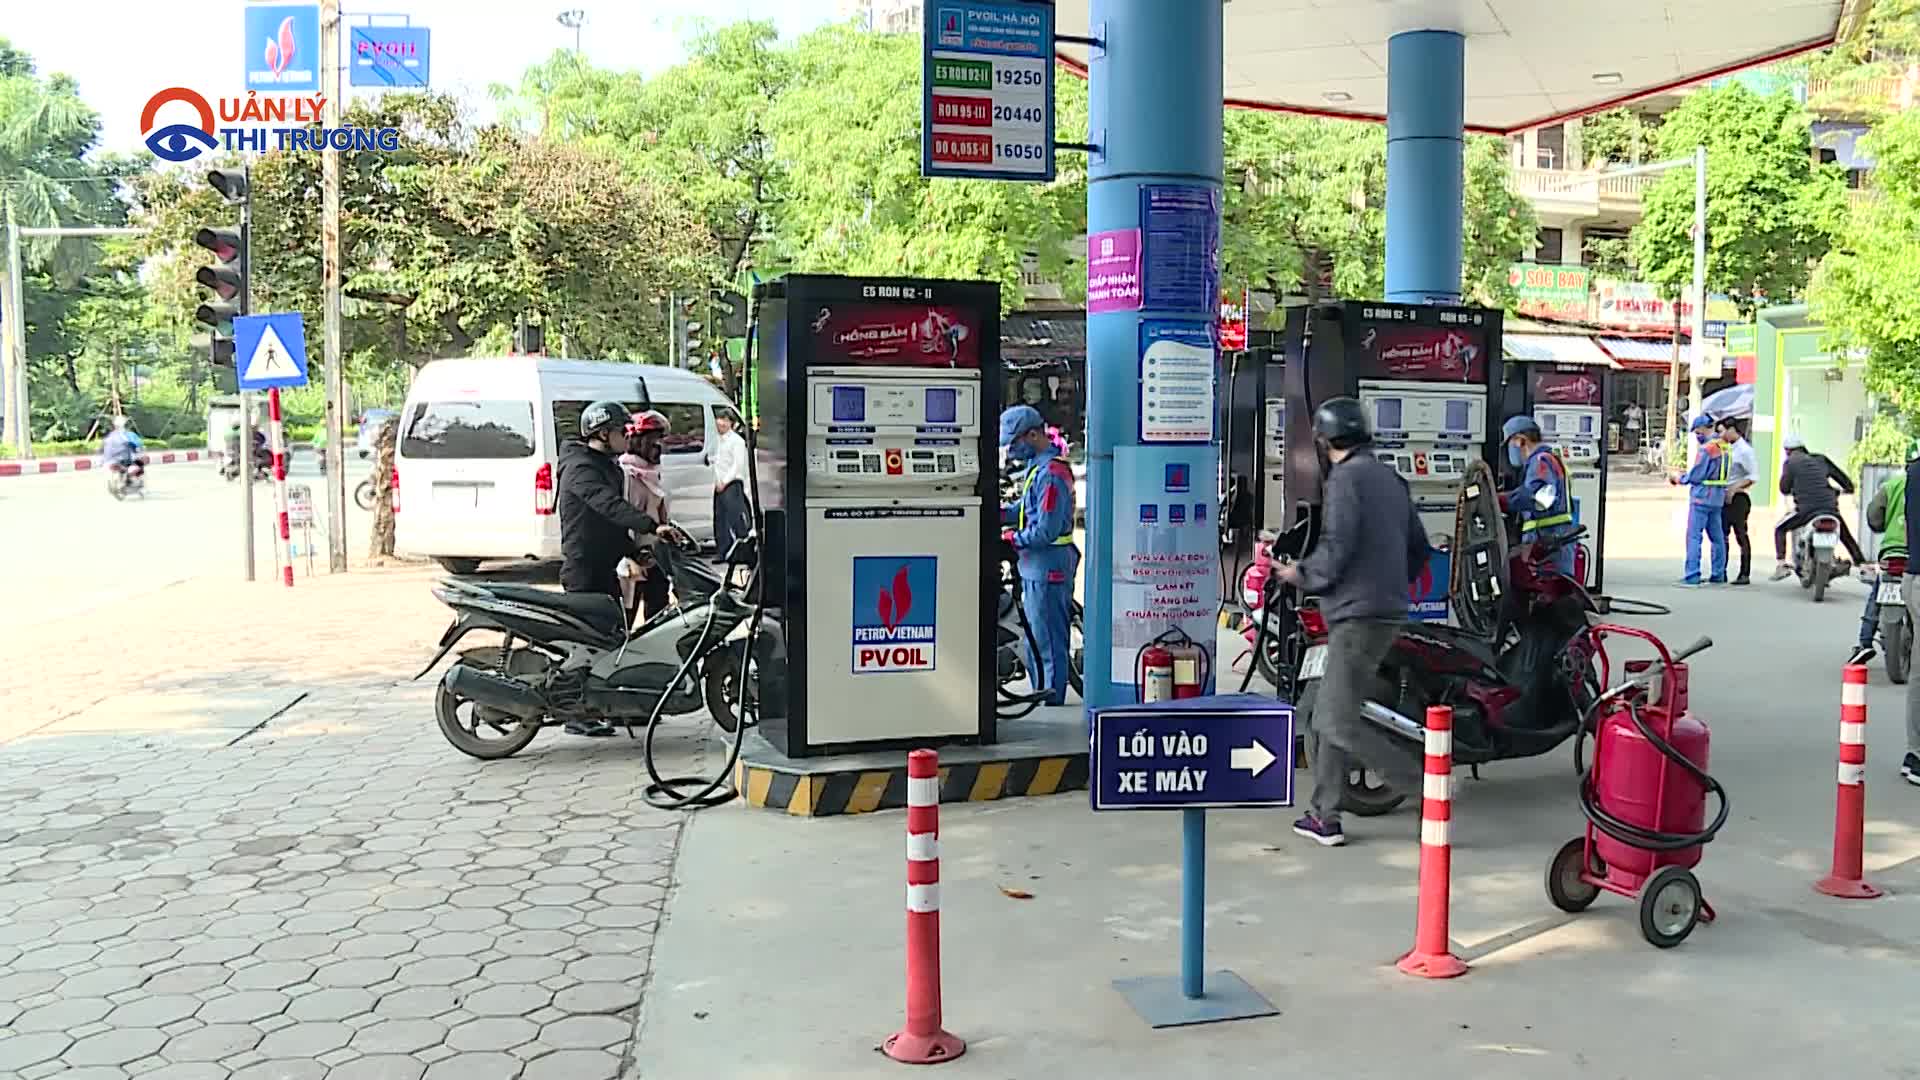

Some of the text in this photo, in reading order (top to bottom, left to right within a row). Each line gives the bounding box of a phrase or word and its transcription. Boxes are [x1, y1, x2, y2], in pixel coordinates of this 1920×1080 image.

[995, 70, 1042, 85] 19250
[938, 103, 959, 117] RON
[994, 106, 1042, 123] 20440
[935, 140, 949, 155] DO
[995, 144, 1043, 160] 16050
[1526, 267, 1585, 289] SÓC BAY
[863, 286, 876, 297] E5
[878, 286, 900, 297] RON
[1111, 284, 1139, 298] TOÁN
[855, 626, 934, 641] PETROVIETNAM
[1118, 728, 1208, 758] LỐI VÀO
[1118, 766, 1208, 793] XE MÁY
